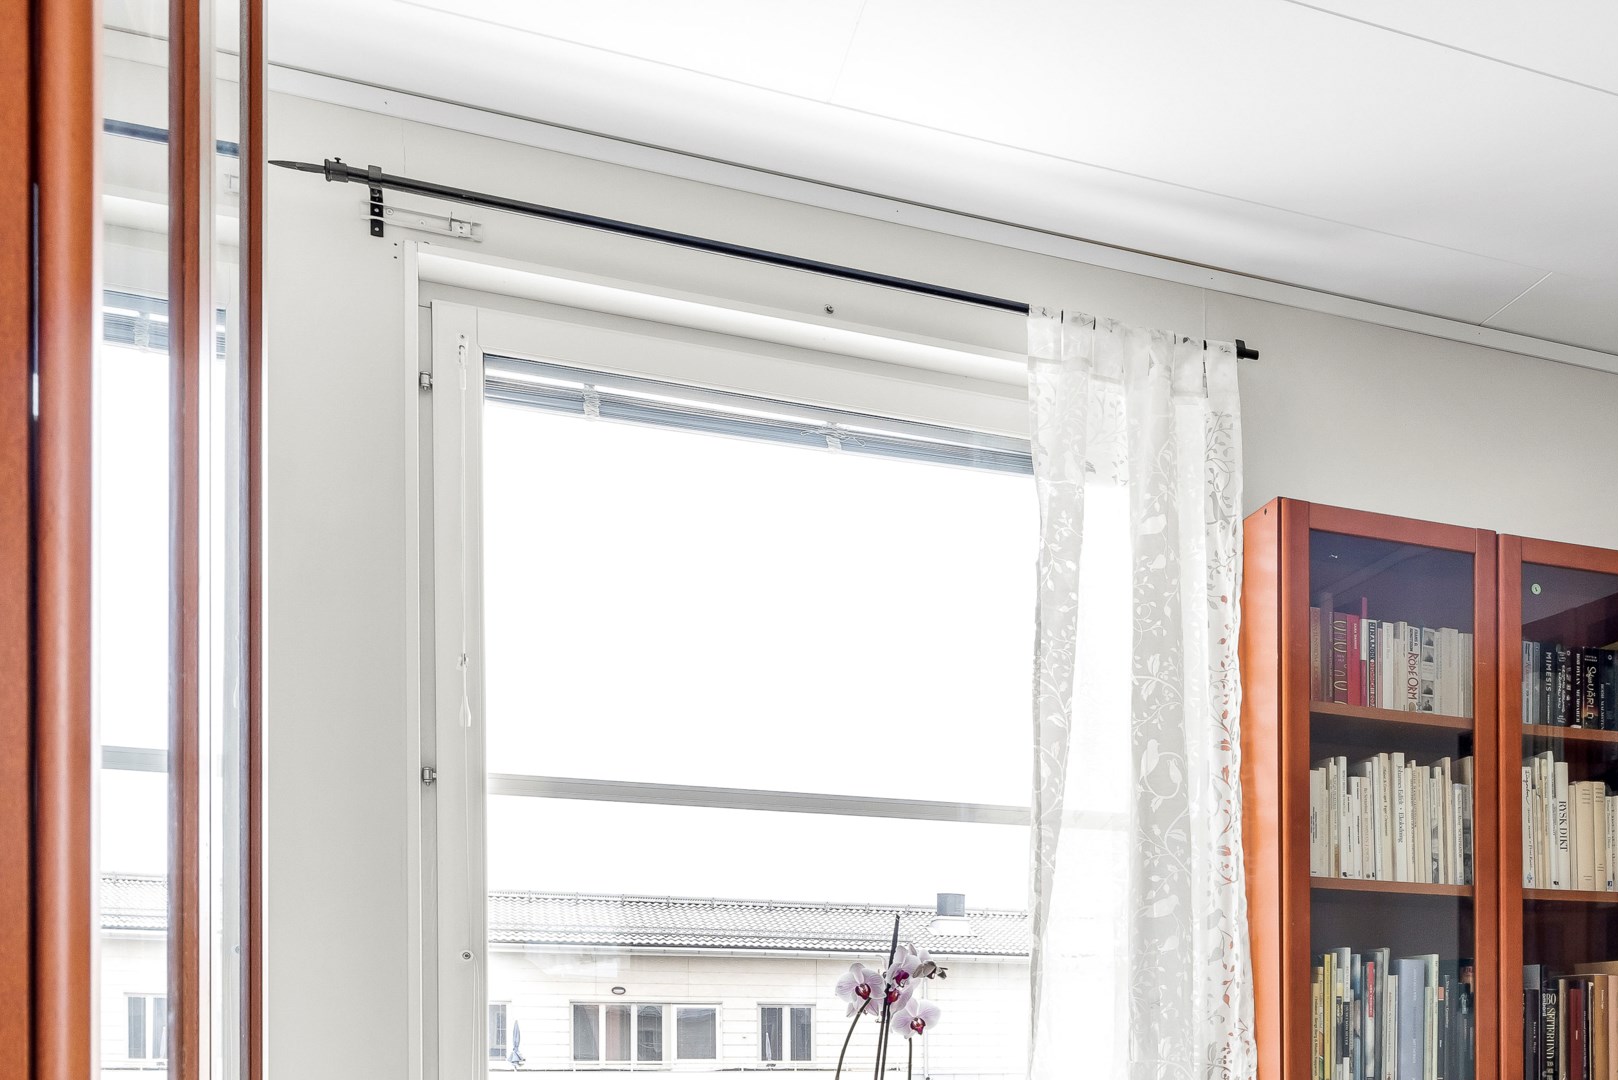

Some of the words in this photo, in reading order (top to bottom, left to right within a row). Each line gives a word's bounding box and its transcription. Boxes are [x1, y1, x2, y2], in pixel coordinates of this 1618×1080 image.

[1407, 652, 1419, 676] RÖDE
[1407, 677, 1419, 699] ORM
[1559, 801, 1567, 826] RYSK
[1559, 827, 1567, 852] DIKT
[1546, 1007, 1556, 1058] SETTERLIND
